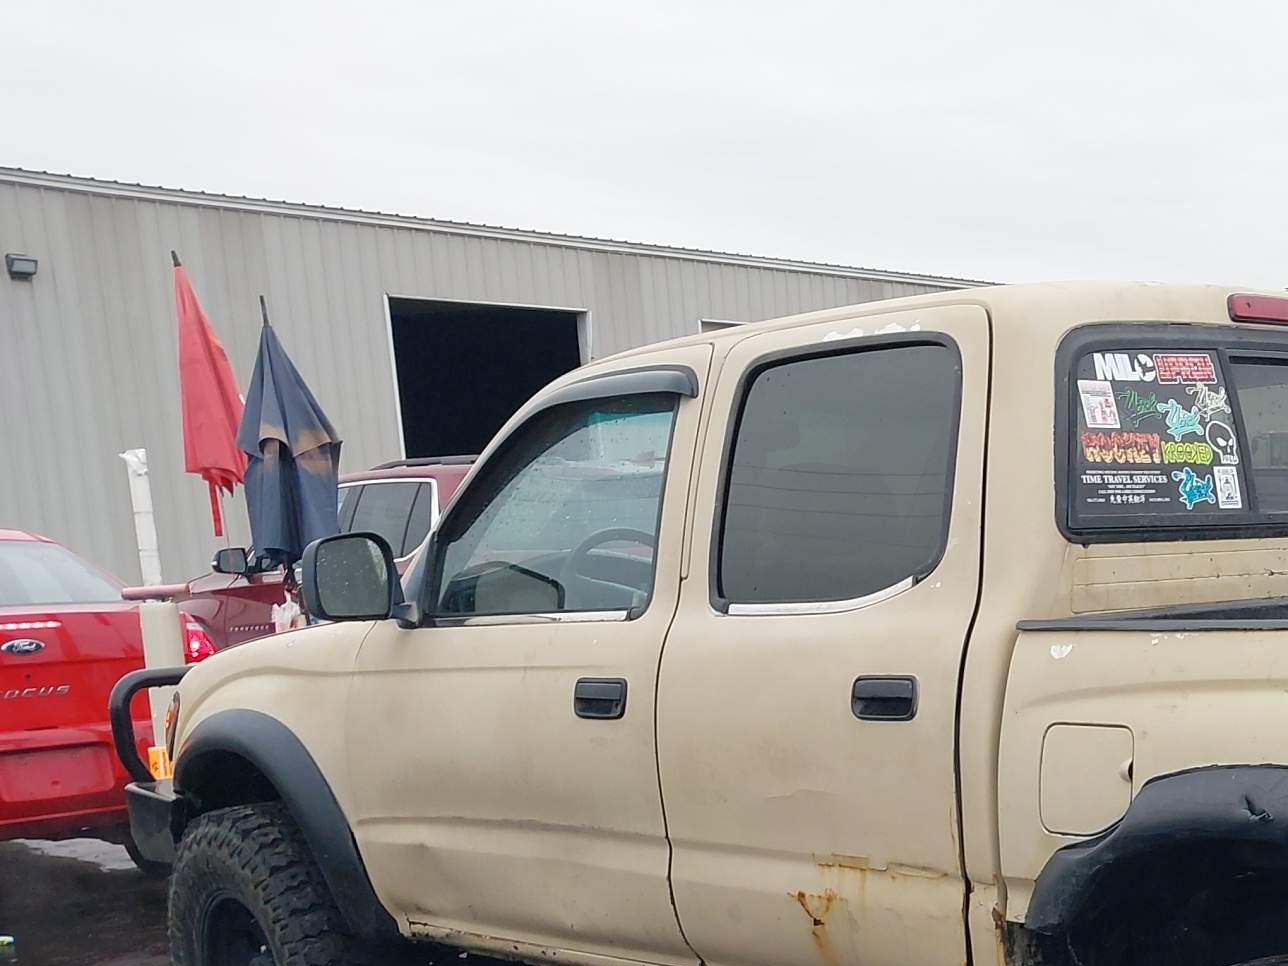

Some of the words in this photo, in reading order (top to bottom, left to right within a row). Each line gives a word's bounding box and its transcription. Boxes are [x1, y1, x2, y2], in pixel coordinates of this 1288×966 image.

[1081, 475, 1103, 484] TIME
[1103, 475, 1133, 484] TRAVEL
[1133, 475, 1168, 484] SERVICES
